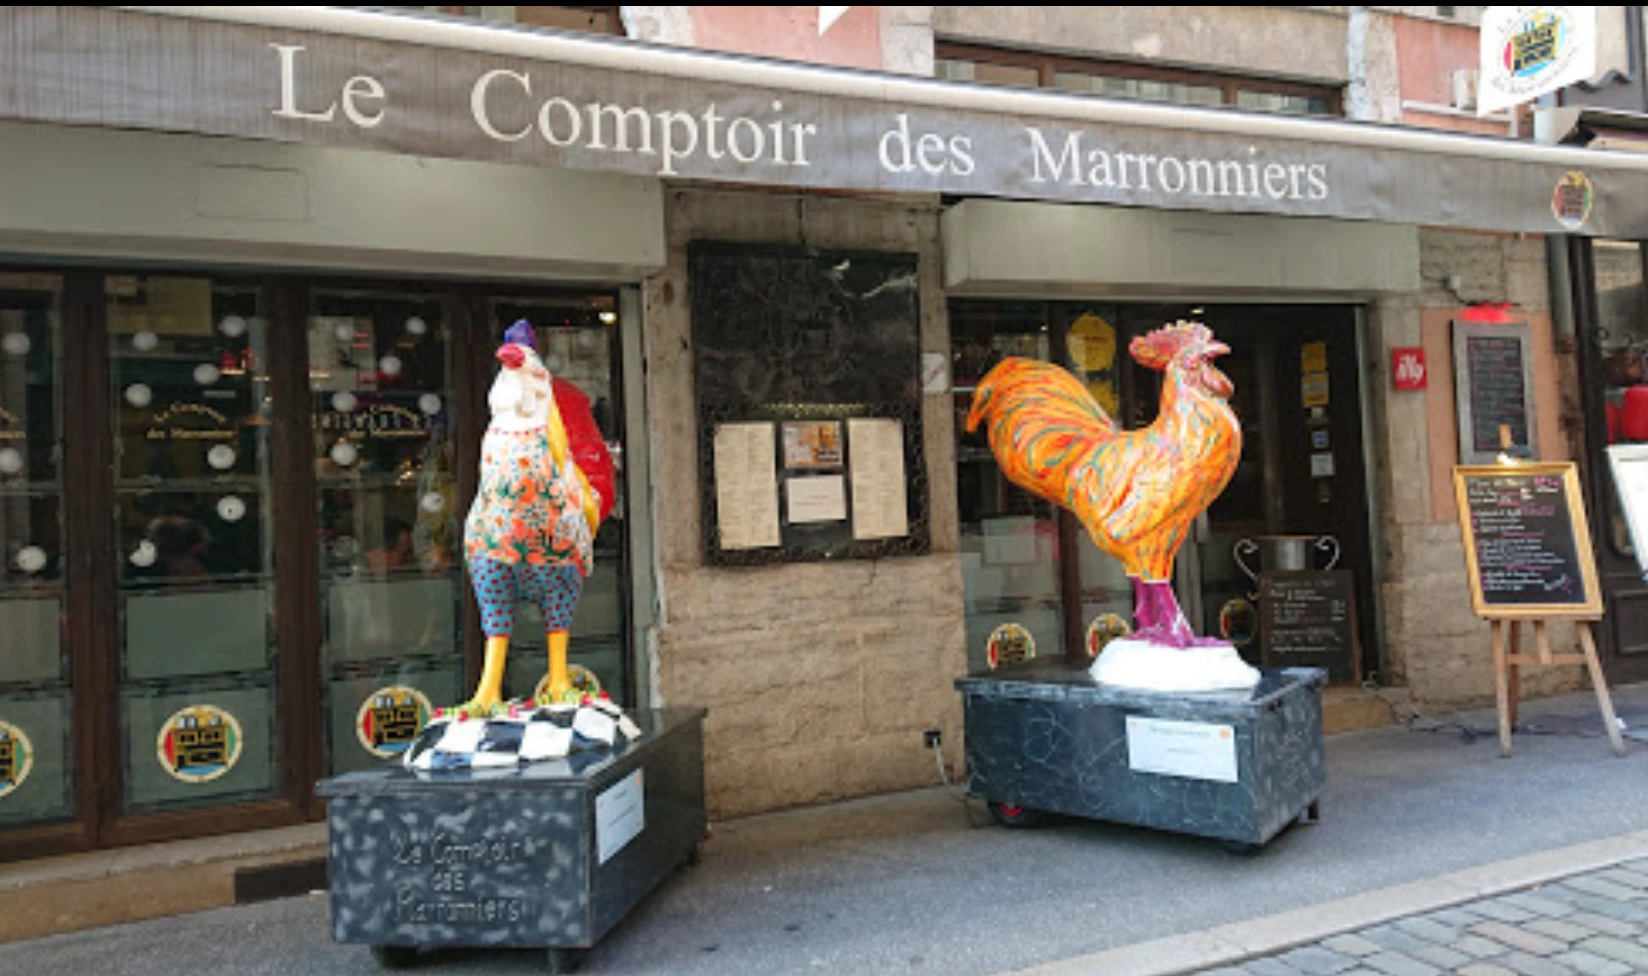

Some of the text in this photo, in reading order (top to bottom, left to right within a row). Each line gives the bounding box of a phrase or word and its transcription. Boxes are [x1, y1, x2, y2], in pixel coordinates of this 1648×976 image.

[268, 42, 1328, 200] Le Comptoir des Marronniers
